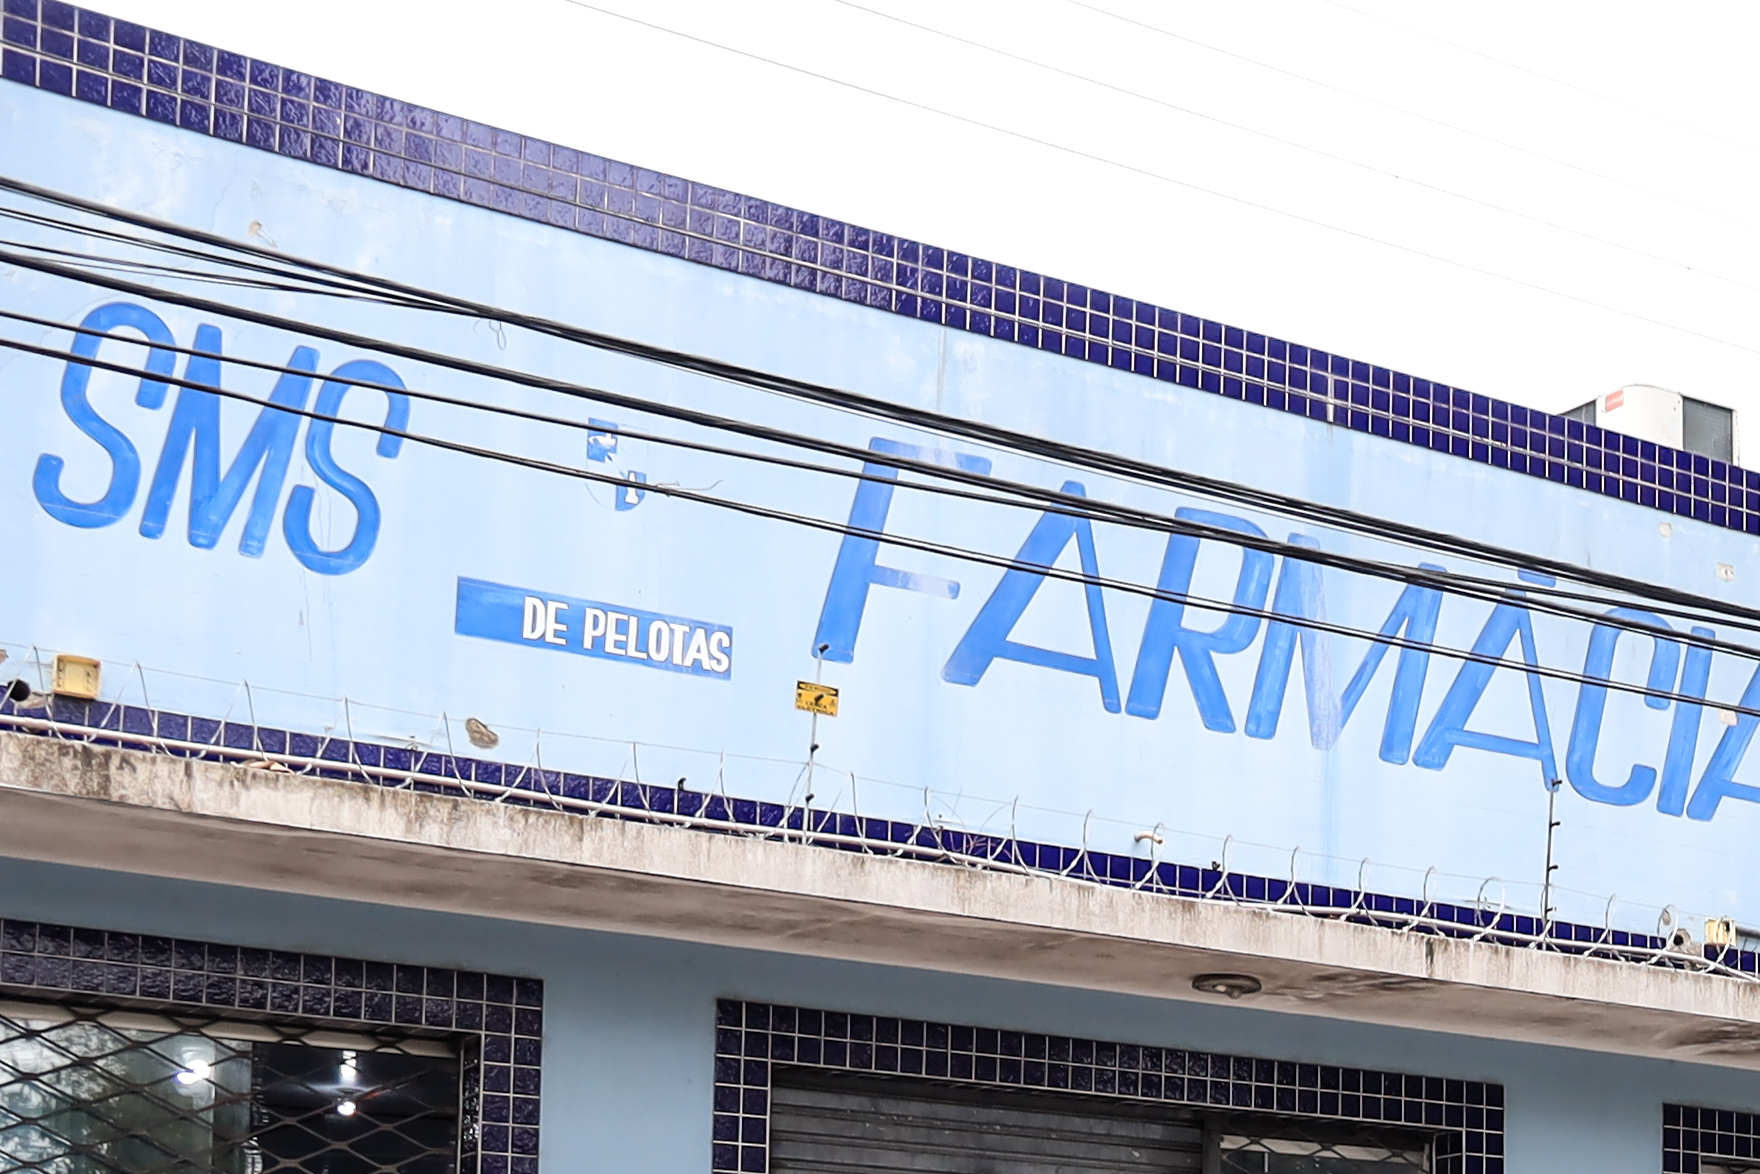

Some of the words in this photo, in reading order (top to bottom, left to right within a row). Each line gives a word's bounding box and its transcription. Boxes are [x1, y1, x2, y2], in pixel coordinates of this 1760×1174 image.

[33, 301, 410, 576] SMS
[522, 595, 569, 646] DE
[583, 607, 731, 673] PELOTAS
